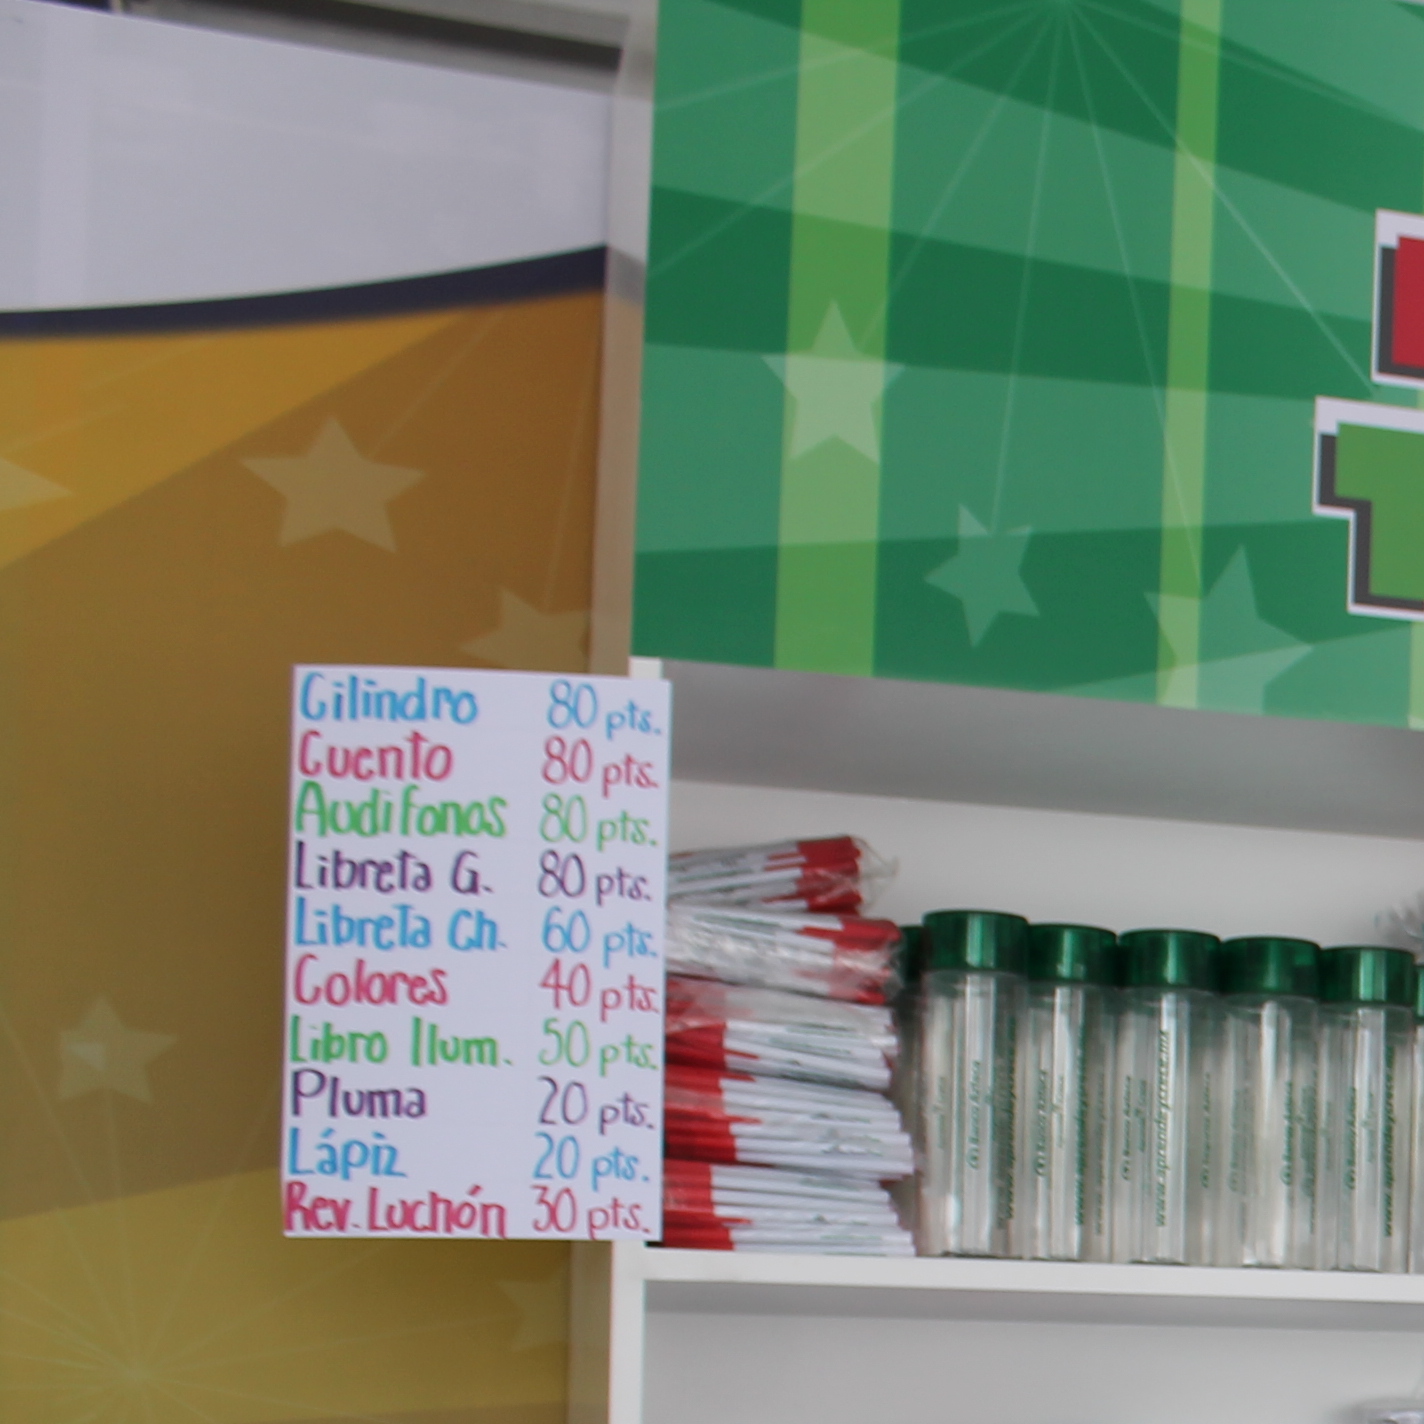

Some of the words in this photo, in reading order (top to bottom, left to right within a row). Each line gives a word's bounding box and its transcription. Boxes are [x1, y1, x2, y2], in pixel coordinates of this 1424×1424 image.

[300, 671, 478, 724] Cilindro
[546, 679, 598, 730] 80
[605, 700, 662, 741] pts.
[299, 730, 453, 781] Cuento
[542, 735, 593, 785] 80
[602, 753, 659, 800] pts.
[540, 792, 588, 843] 80
[597, 810, 658, 853] pts.
[295, 840, 432, 893] Libreta
[451, 850, 494, 895] G.
[538, 850, 586, 898] 80
[596, 867, 652, 907] pts.
[294, 896, 431, 951] Libreta
[447, 909, 508, 951] Ch.
[542, 905, 591, 953] 60
[603, 921, 657, 968] pts.
[294, 953, 447, 1006] Colores
[539, 958, 591, 1010] 40
[599, 974, 660, 1023] pts.
[290, 1014, 388, 1063] Libro
[538, 1018, 591, 1067] 50
[599, 1034, 659, 1077] pts.
[291, 1068, 427, 1118] Pluma
[537, 1076, 589, 1126] 20
[598, 1091, 655, 1136] pts.
[288, 1126, 408, 1181] Lápiz
[532, 1132, 579, 1180] 20
[591, 1147, 650, 1192] pts.
[367, 1184, 508, 1239] Luchón
[531, 1185, 577, 1233] 30
[587, 1198, 652, 1241] pts.
